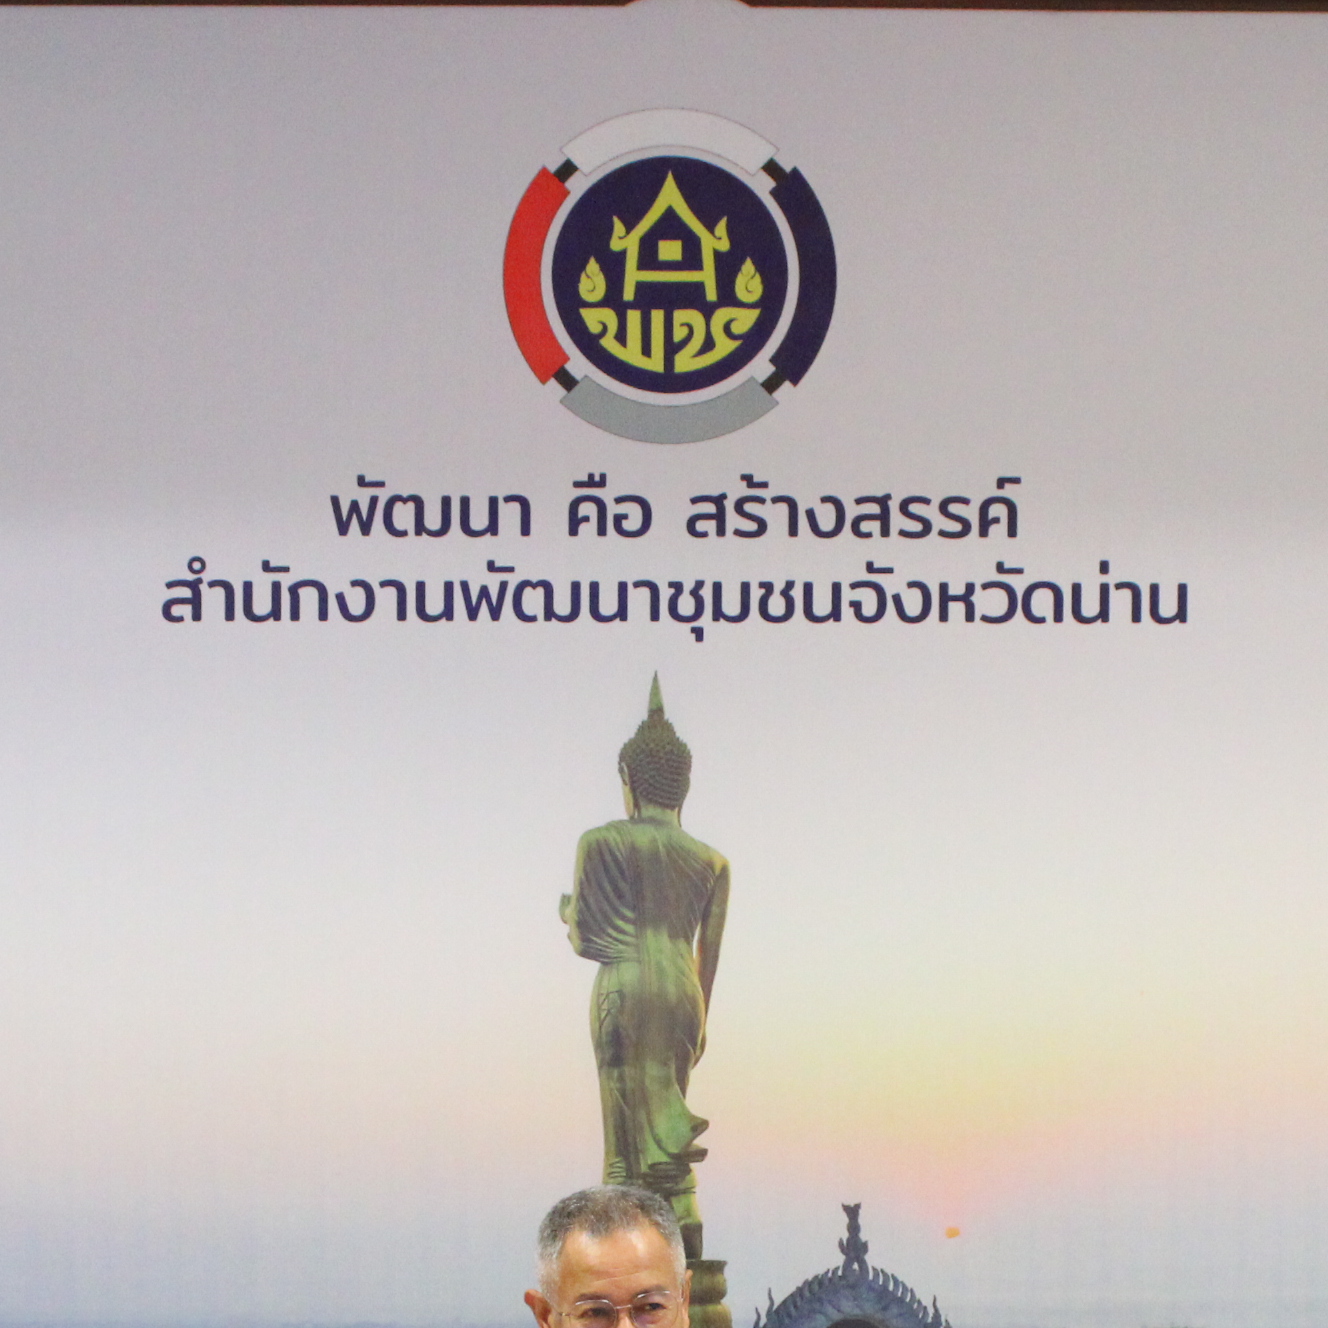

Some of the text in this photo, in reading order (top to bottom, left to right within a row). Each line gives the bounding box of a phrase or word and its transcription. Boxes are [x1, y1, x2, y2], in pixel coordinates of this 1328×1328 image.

[329, 472, 1023, 540] พัฒนา คือ สร้างสรรค์
[160, 556, 1189, 643] สำนักงานพัฒนาชุมชนจังหวัดน่าน
